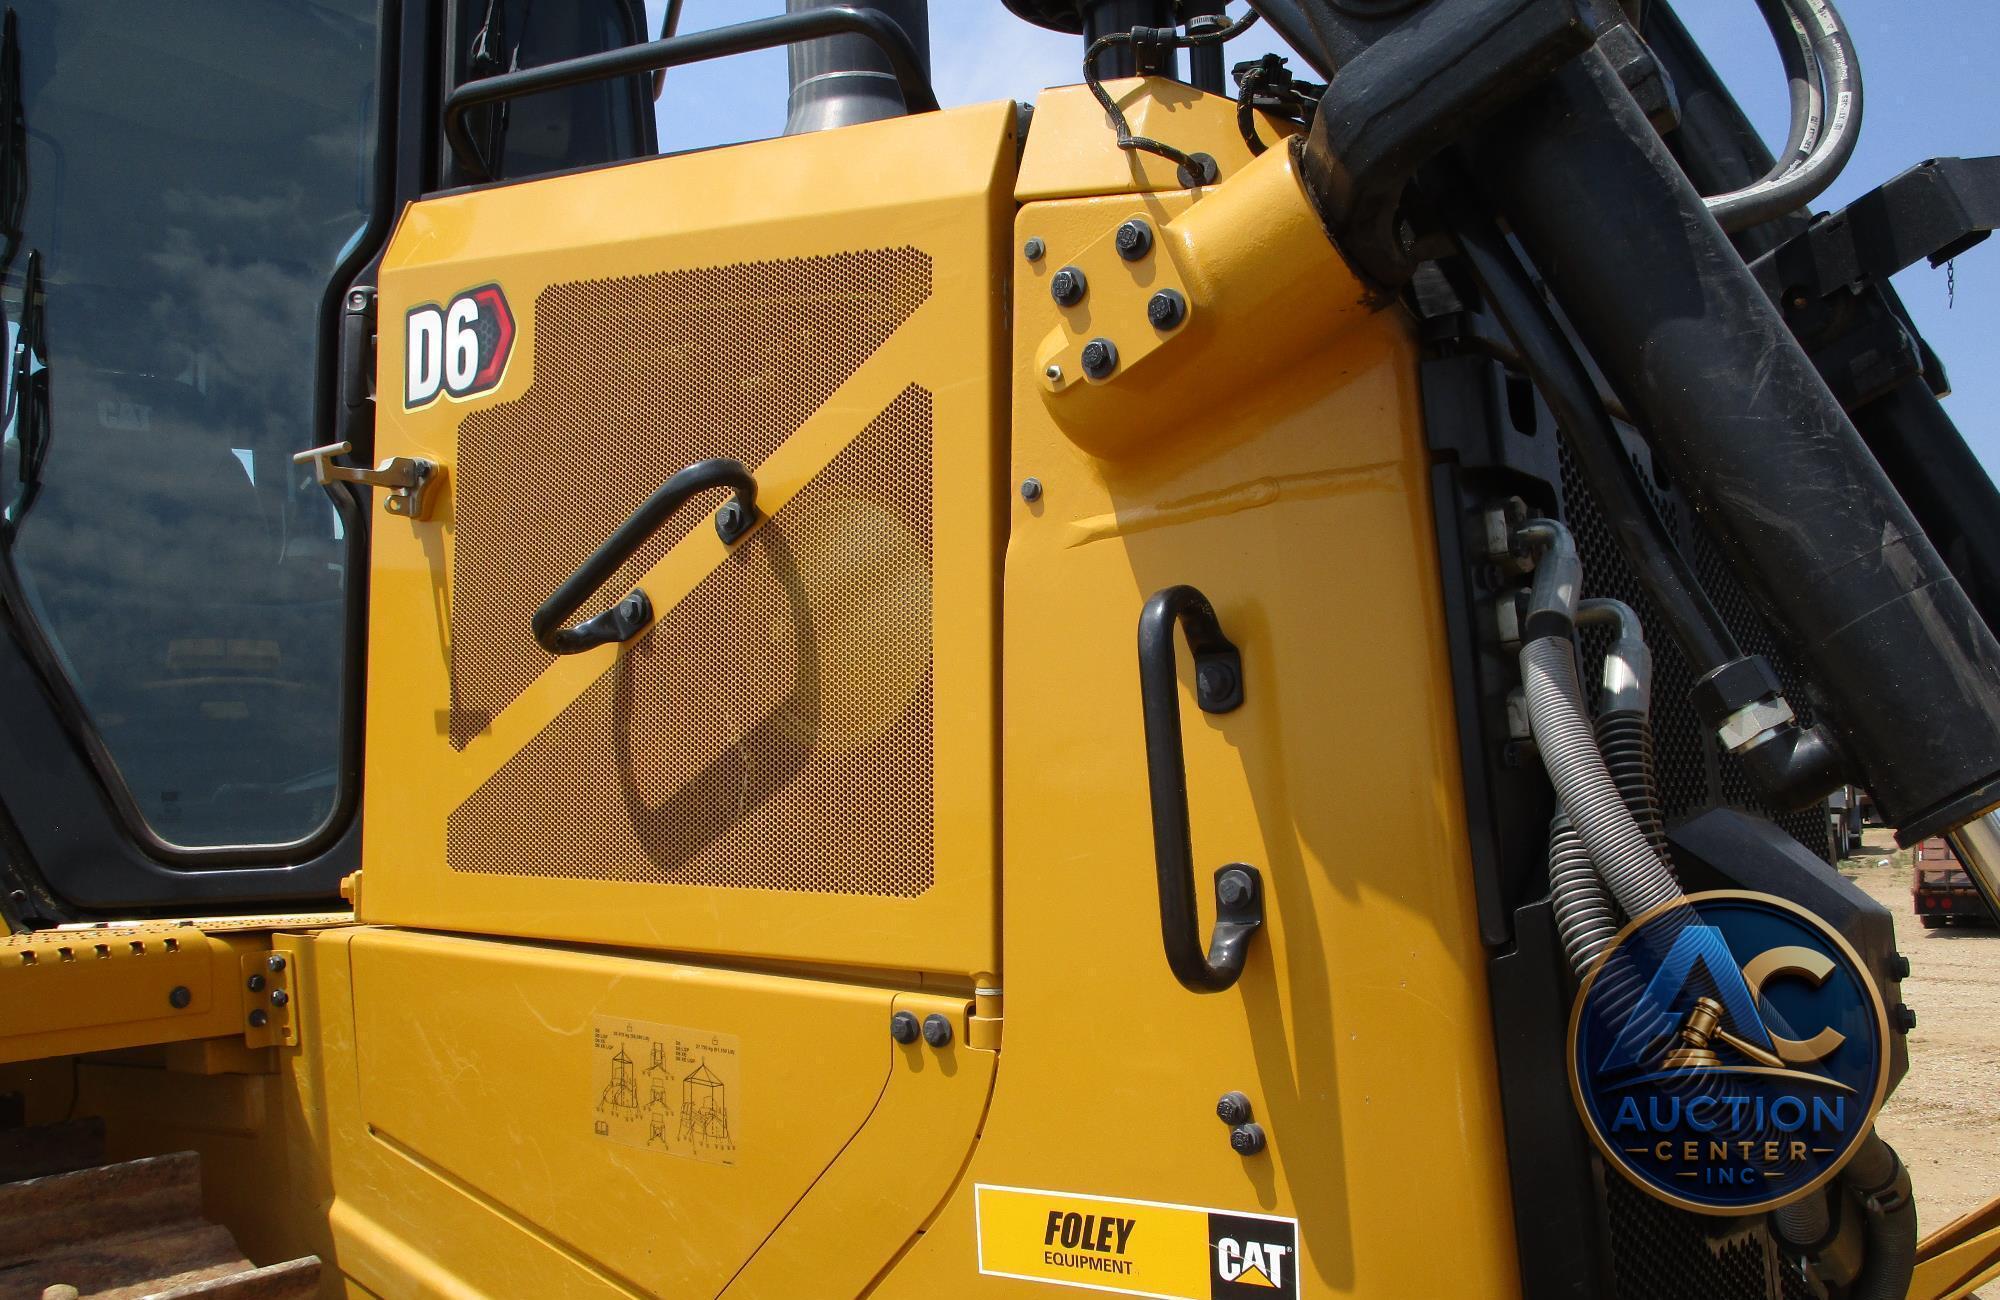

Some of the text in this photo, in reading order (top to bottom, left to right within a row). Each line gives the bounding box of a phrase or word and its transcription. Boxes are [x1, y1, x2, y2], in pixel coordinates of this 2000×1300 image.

[408, 297, 479, 402] D6
[1044, 1210, 1136, 1255] FOLEY
[1044, 1251, 1133, 1275] EQUIPMENT
